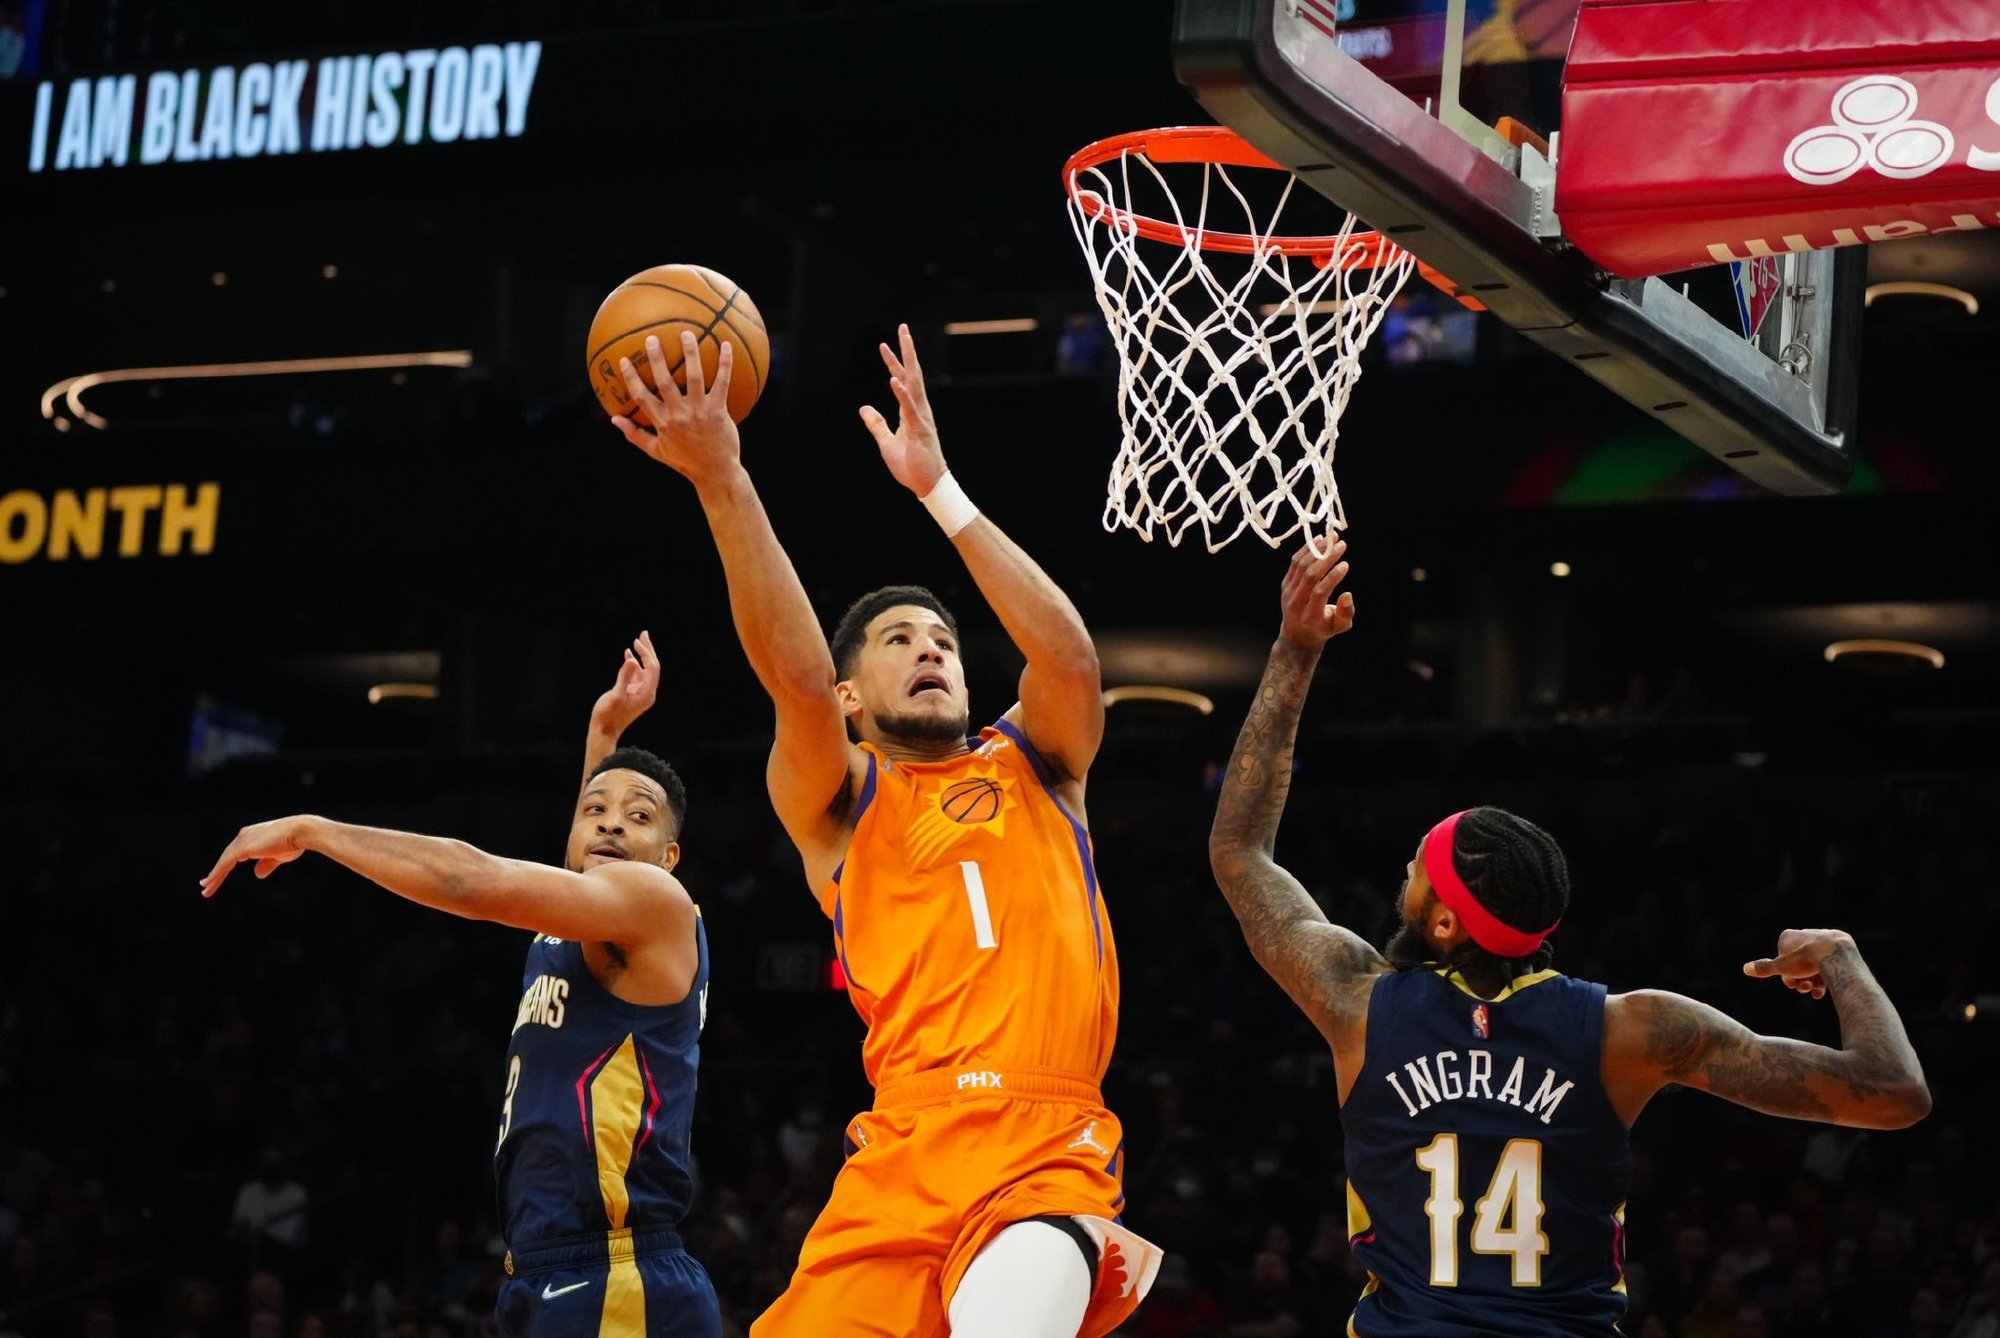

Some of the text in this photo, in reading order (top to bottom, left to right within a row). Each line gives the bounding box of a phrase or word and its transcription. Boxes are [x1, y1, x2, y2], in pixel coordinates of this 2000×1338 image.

[28, 41, 542, 173] I AM BLACK HISTORY
[0, 483, 220, 564] ONTH
[958, 861, 999, 949] 1
[957, 1071, 1002, 1090] PHX
[1385, 1050, 1575, 1125] INGRAM
[1415, 1133, 1550, 1287] 14
